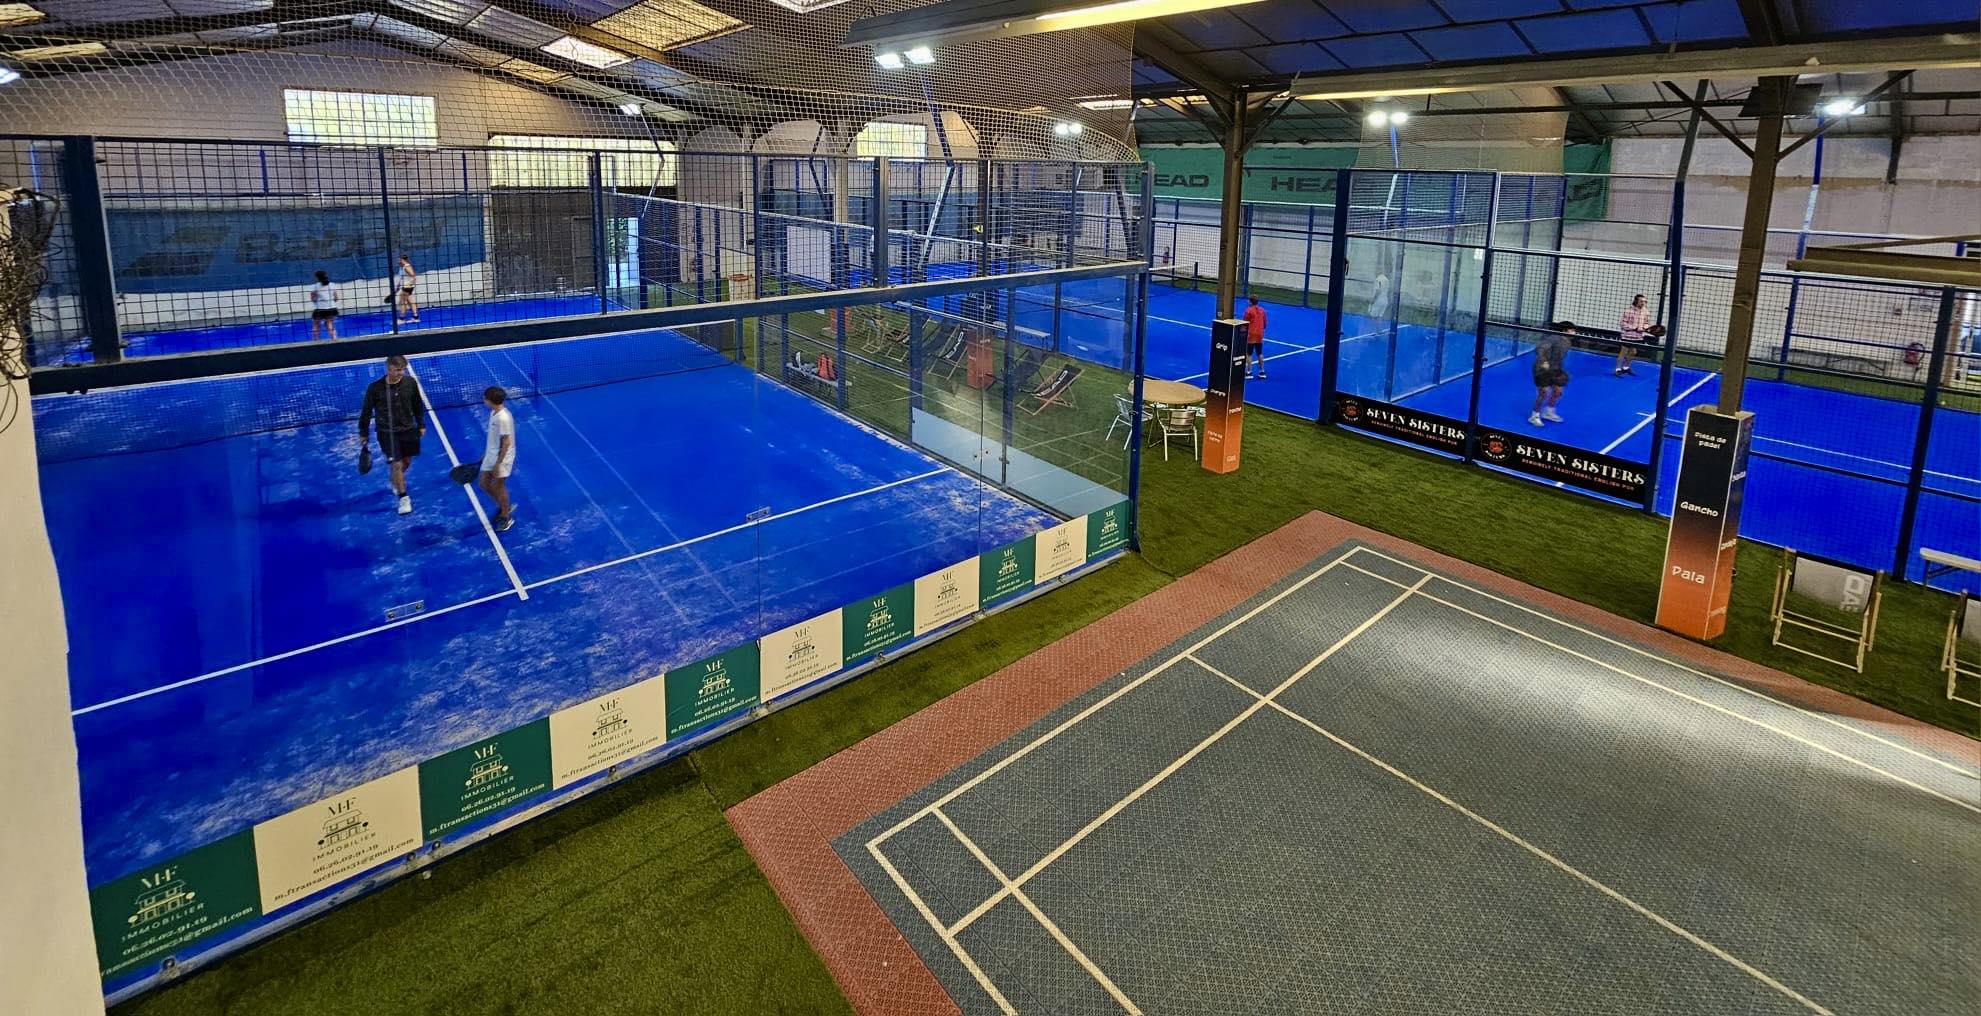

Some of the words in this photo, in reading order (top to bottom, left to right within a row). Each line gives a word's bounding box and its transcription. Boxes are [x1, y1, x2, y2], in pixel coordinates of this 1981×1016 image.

[1271, 176, 1337, 192] HEA
[1366, 407, 1406, 425] SEVEN
[1409, 418, 1466, 441] SISTERS
[1516, 444, 1568, 466] SEVEN
[1571, 458, 1647, 486] SISTERS
[1680, 501, 1719, 517] Gancho
[1672, 565, 1706, 585] Pala
[694, 687, 735, 707] IMMOBILIER
[588, 728, 633, 749] IMMOBILIER
[461, 775, 514, 800] IMMOBILIER
[312, 832, 377, 862] IMMOBILIER
[121, 902, 205, 942] IMMOBILIER
